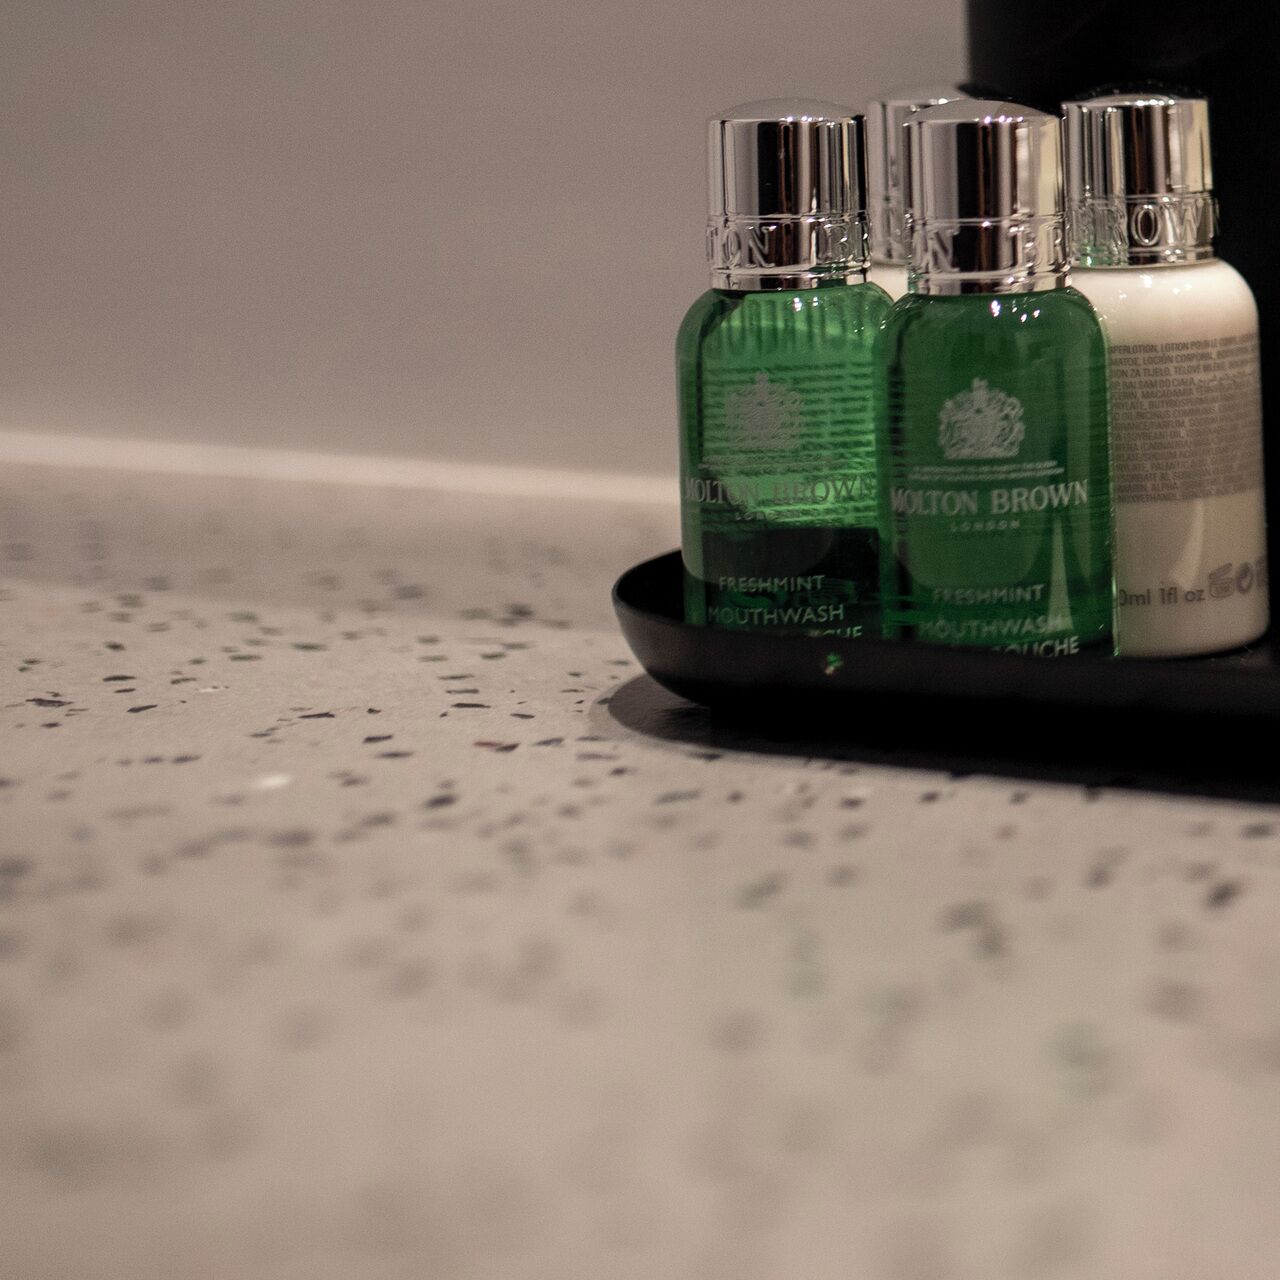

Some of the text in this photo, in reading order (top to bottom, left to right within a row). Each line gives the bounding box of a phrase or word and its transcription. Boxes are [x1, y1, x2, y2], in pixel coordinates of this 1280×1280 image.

[684, 473, 873, 505] MOLTON BROWN
[890, 479, 1089, 516] MOLTON BROWN
[718, 575, 826, 593] FRESHMINT
[932, 584, 1045, 606] FRESHMINT
[1119, 589, 1151, 606] 0ml
[1184, 589, 1206, 602] oz
[707, 603, 846, 625] MOUTHWASH
